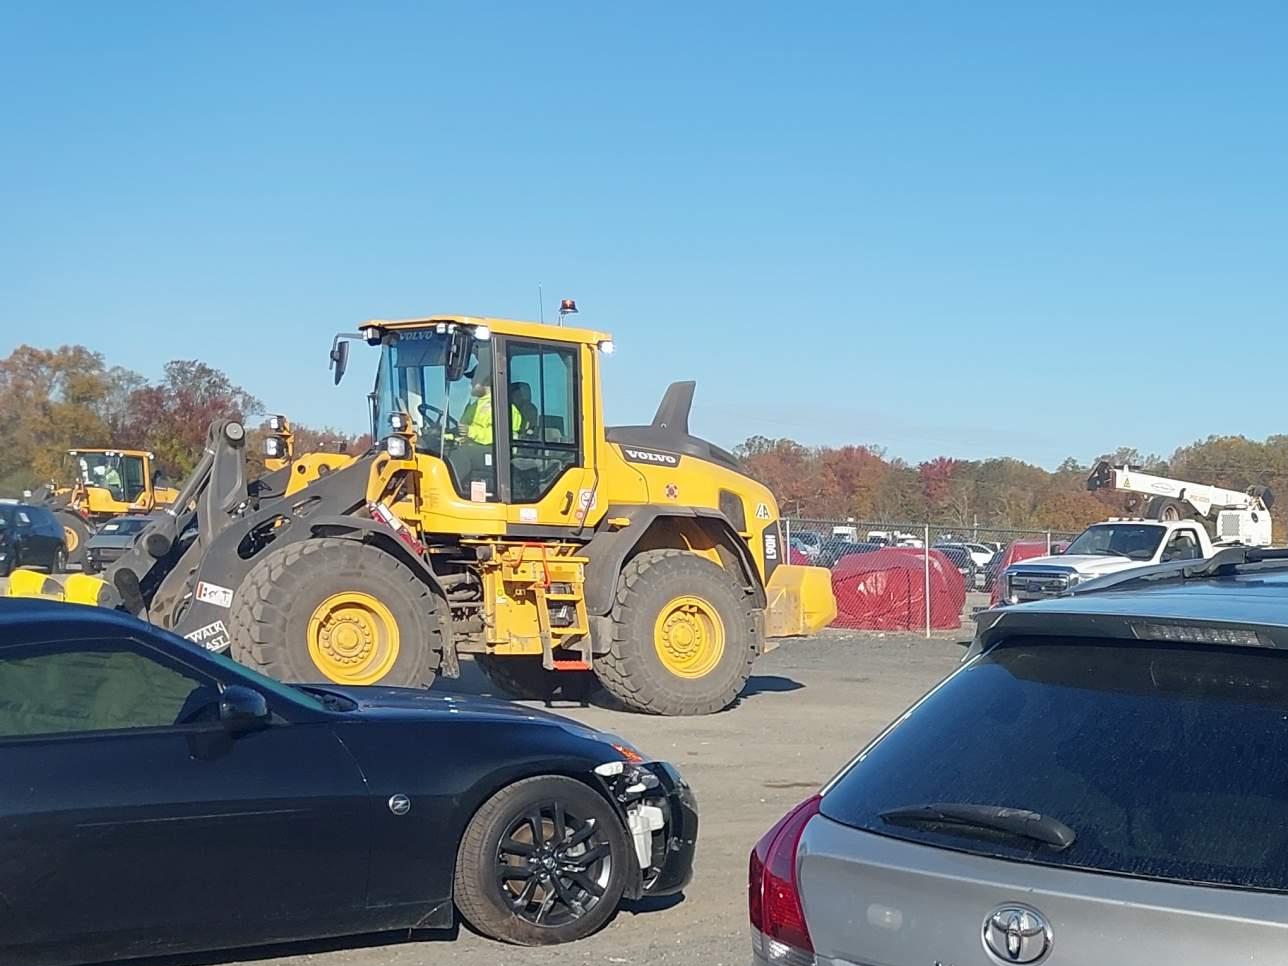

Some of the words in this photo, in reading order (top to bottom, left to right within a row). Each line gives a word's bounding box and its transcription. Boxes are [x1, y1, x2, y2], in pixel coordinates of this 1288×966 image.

[400, 330, 433, 341] VOLVO
[625, 449, 676, 464] VOLVO
[764, 534, 777, 560] L90H
[189, 622, 224, 643] WALK
[201, 635, 225, 651] AST
